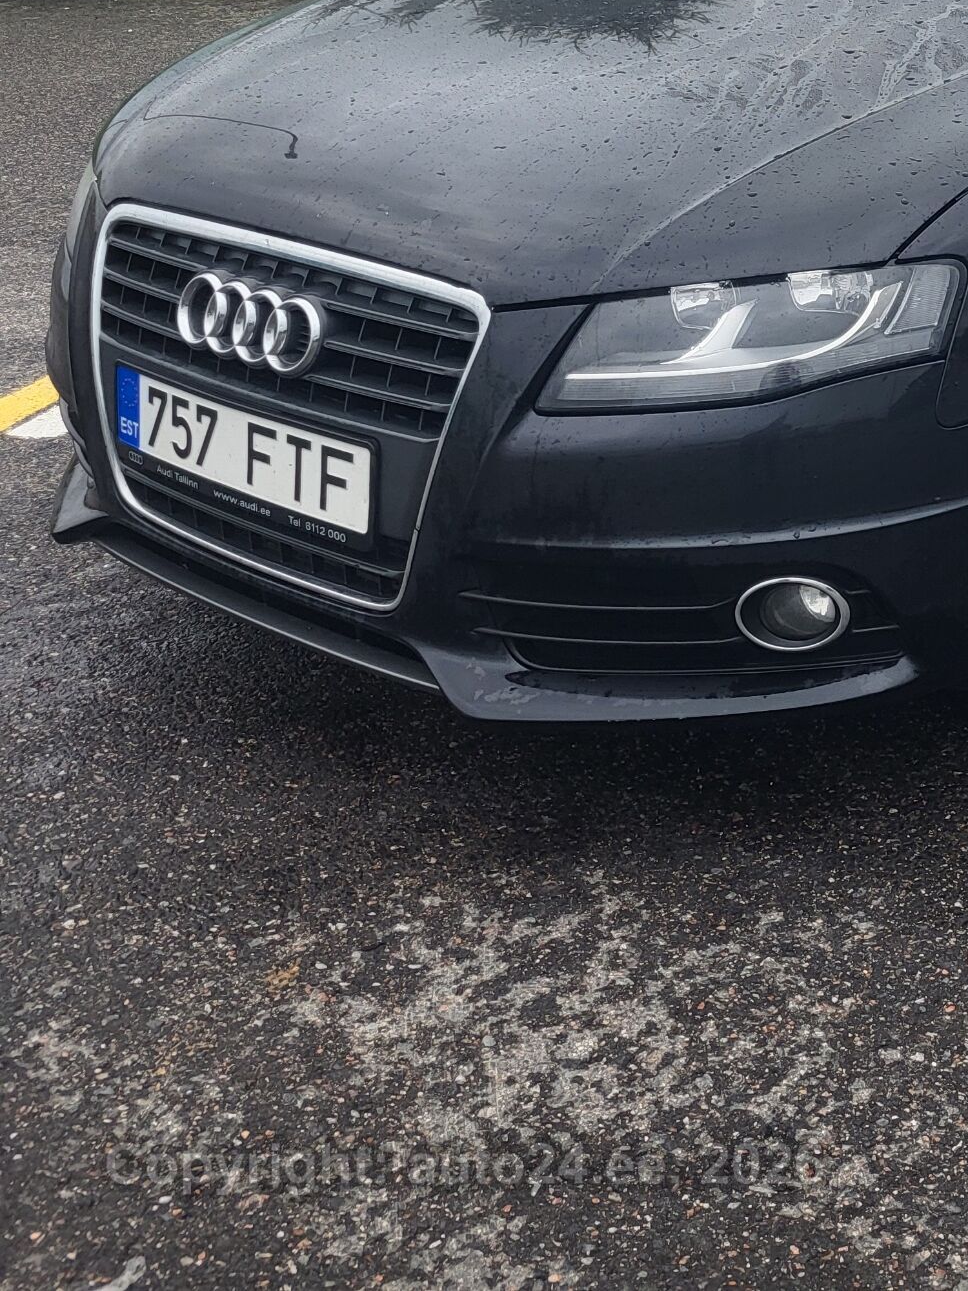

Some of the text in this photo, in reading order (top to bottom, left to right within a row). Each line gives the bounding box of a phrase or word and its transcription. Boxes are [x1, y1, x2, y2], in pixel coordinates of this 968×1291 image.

[120, 416, 139, 438] EST
[148, 385, 355, 512] 757 FTF
[157, 465, 173, 478] Audi
[174, 471, 199, 490] Tallinn
[213, 490, 271, 516] www.audi.ee
[288, 515, 301, 527] Tel
[327, 529, 347, 543] 000
